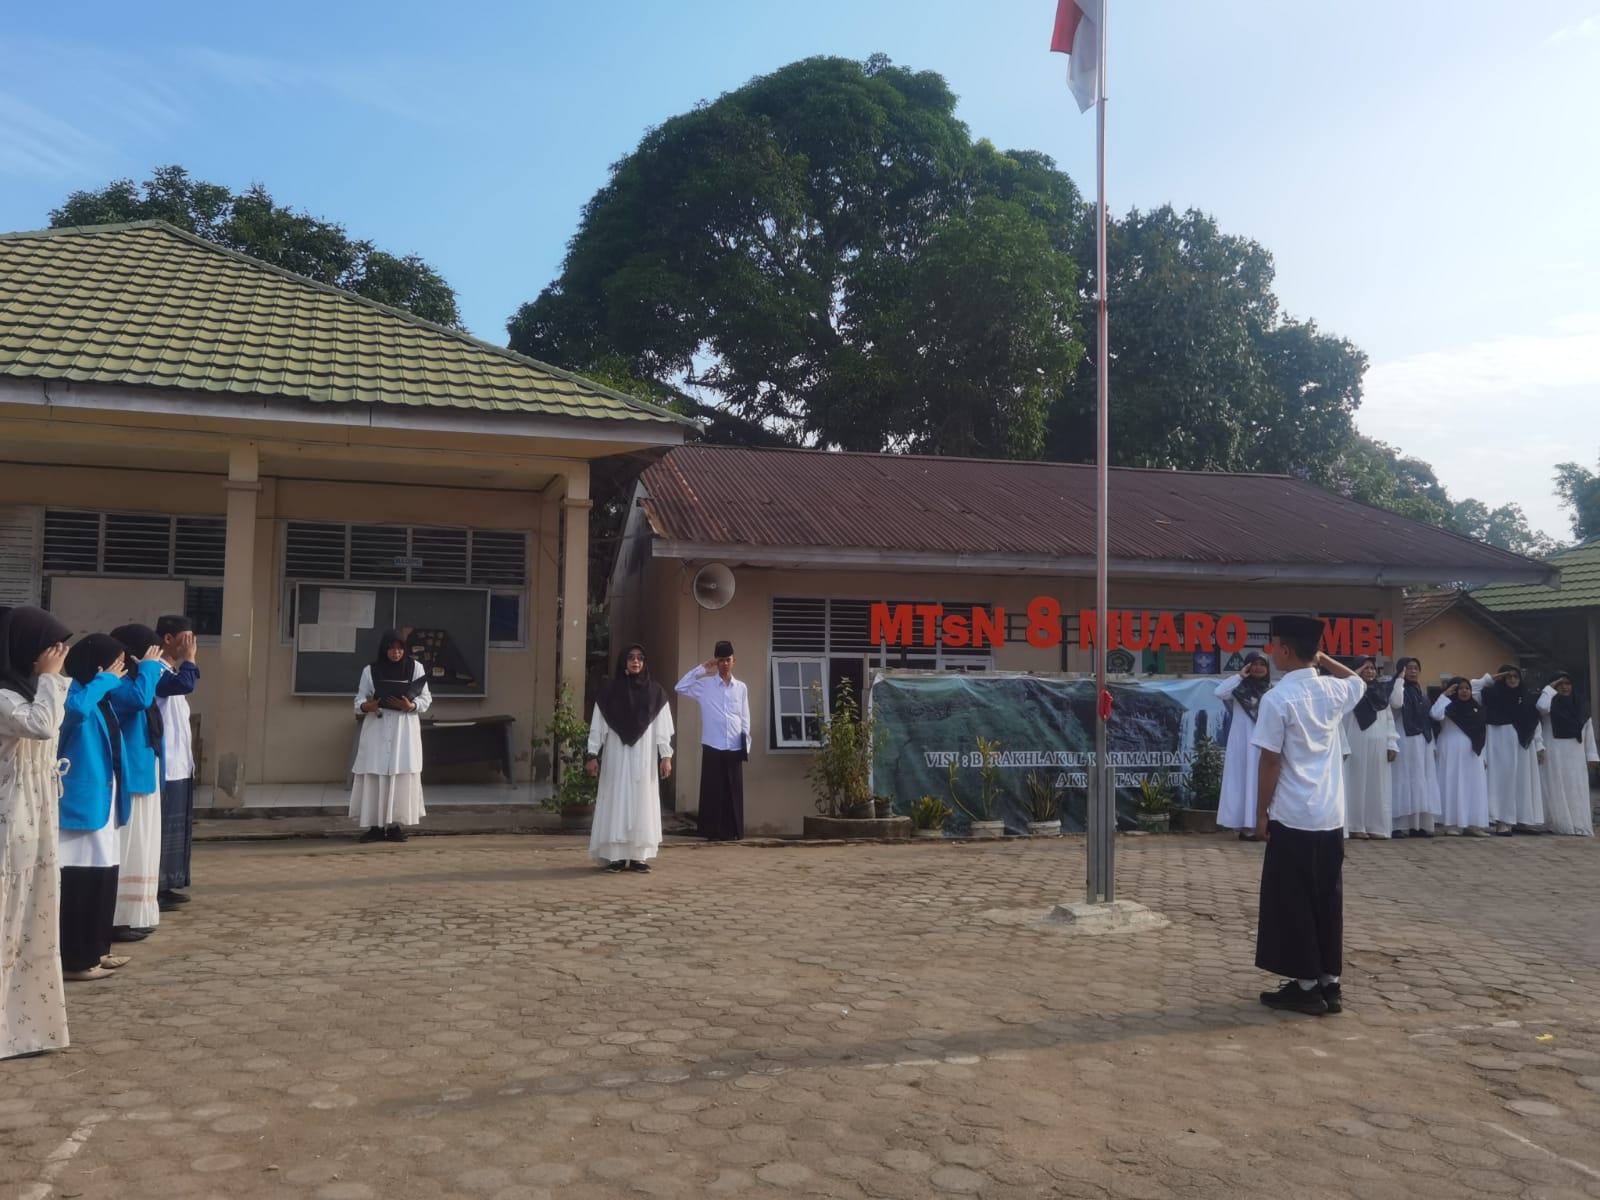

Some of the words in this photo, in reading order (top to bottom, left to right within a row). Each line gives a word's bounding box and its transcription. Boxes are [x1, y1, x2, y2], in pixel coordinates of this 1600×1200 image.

[870, 603, 1005, 647] MTsN
[1025, 597, 1061, 648] 8
[1079, 608, 1247, 654] MUARO
[1263, 614, 1394, 657] MBI
[924, 751, 959, 767] VISI
[970, 750, 1087, 767] BRAKHLAKUL
[1162, 750, 1193, 766] DAN
